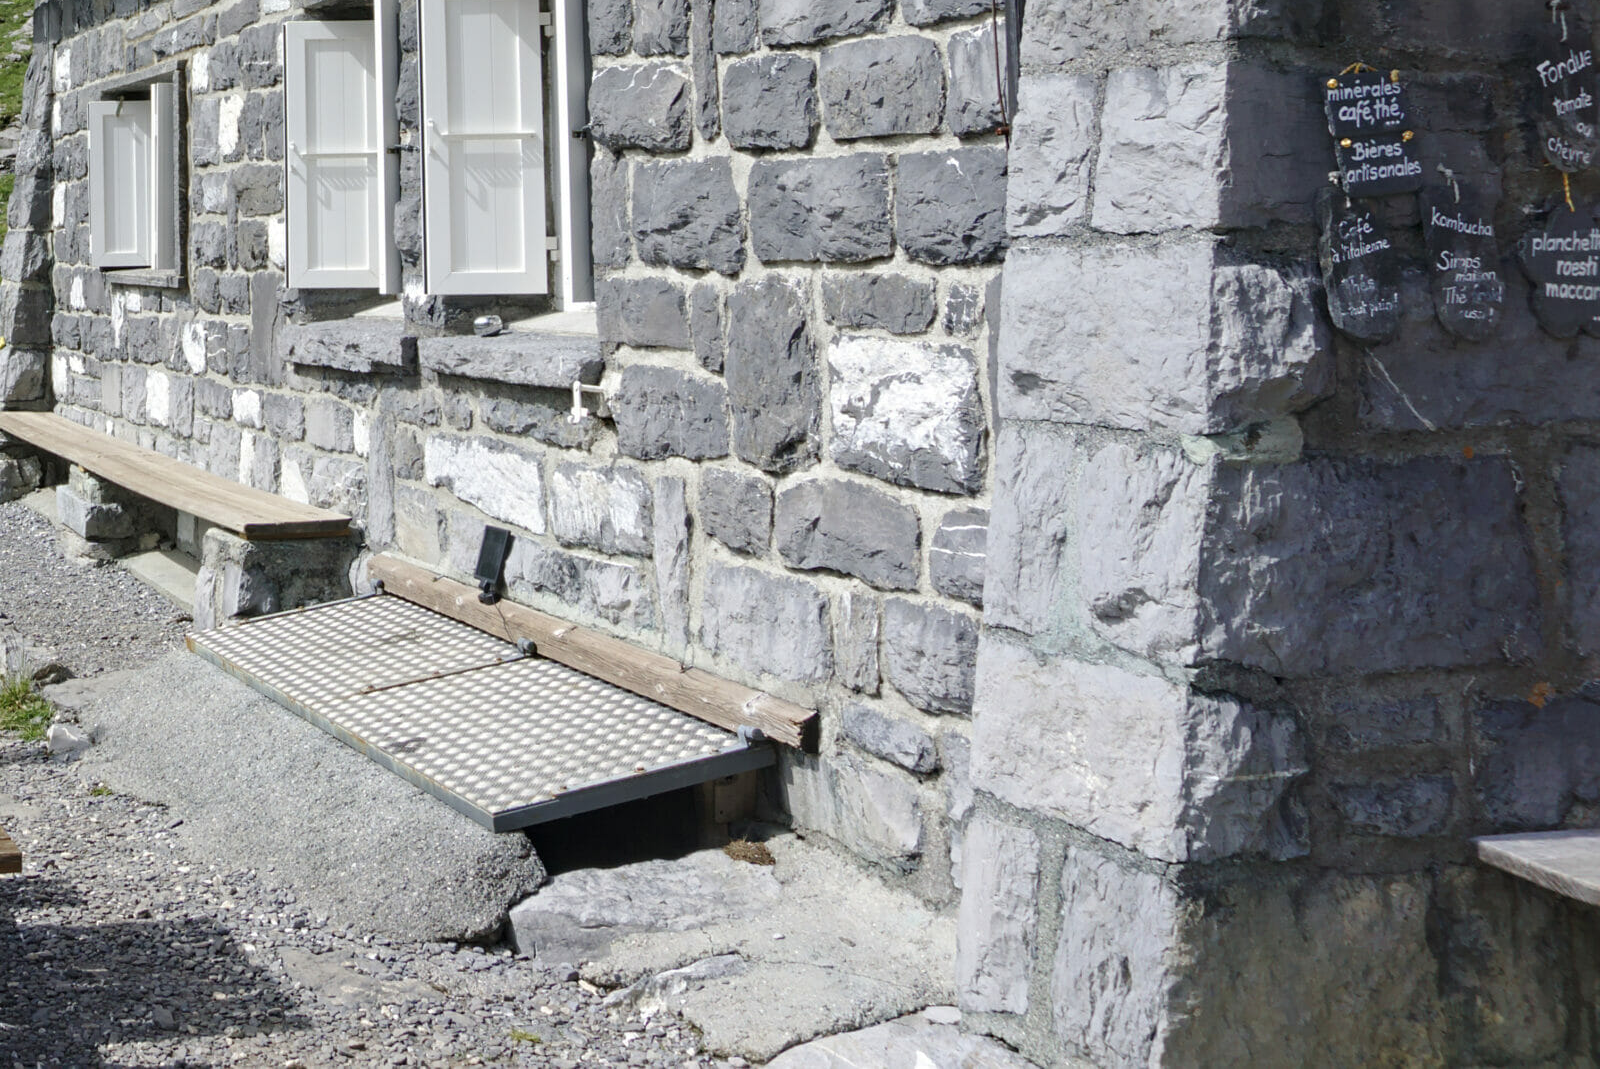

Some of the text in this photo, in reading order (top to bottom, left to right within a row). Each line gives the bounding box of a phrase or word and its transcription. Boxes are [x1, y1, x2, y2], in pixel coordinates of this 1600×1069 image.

[1326, 75, 1401, 101] minérales
[1551, 85, 1593, 117] tomate
[1575, 121, 1593, 138] ou
[1351, 138, 1403, 161] Bières
[1345, 155, 1423, 183] artisanales
[1338, 212, 1374, 239] Café
[1555, 255, 1599, 277] roesti
